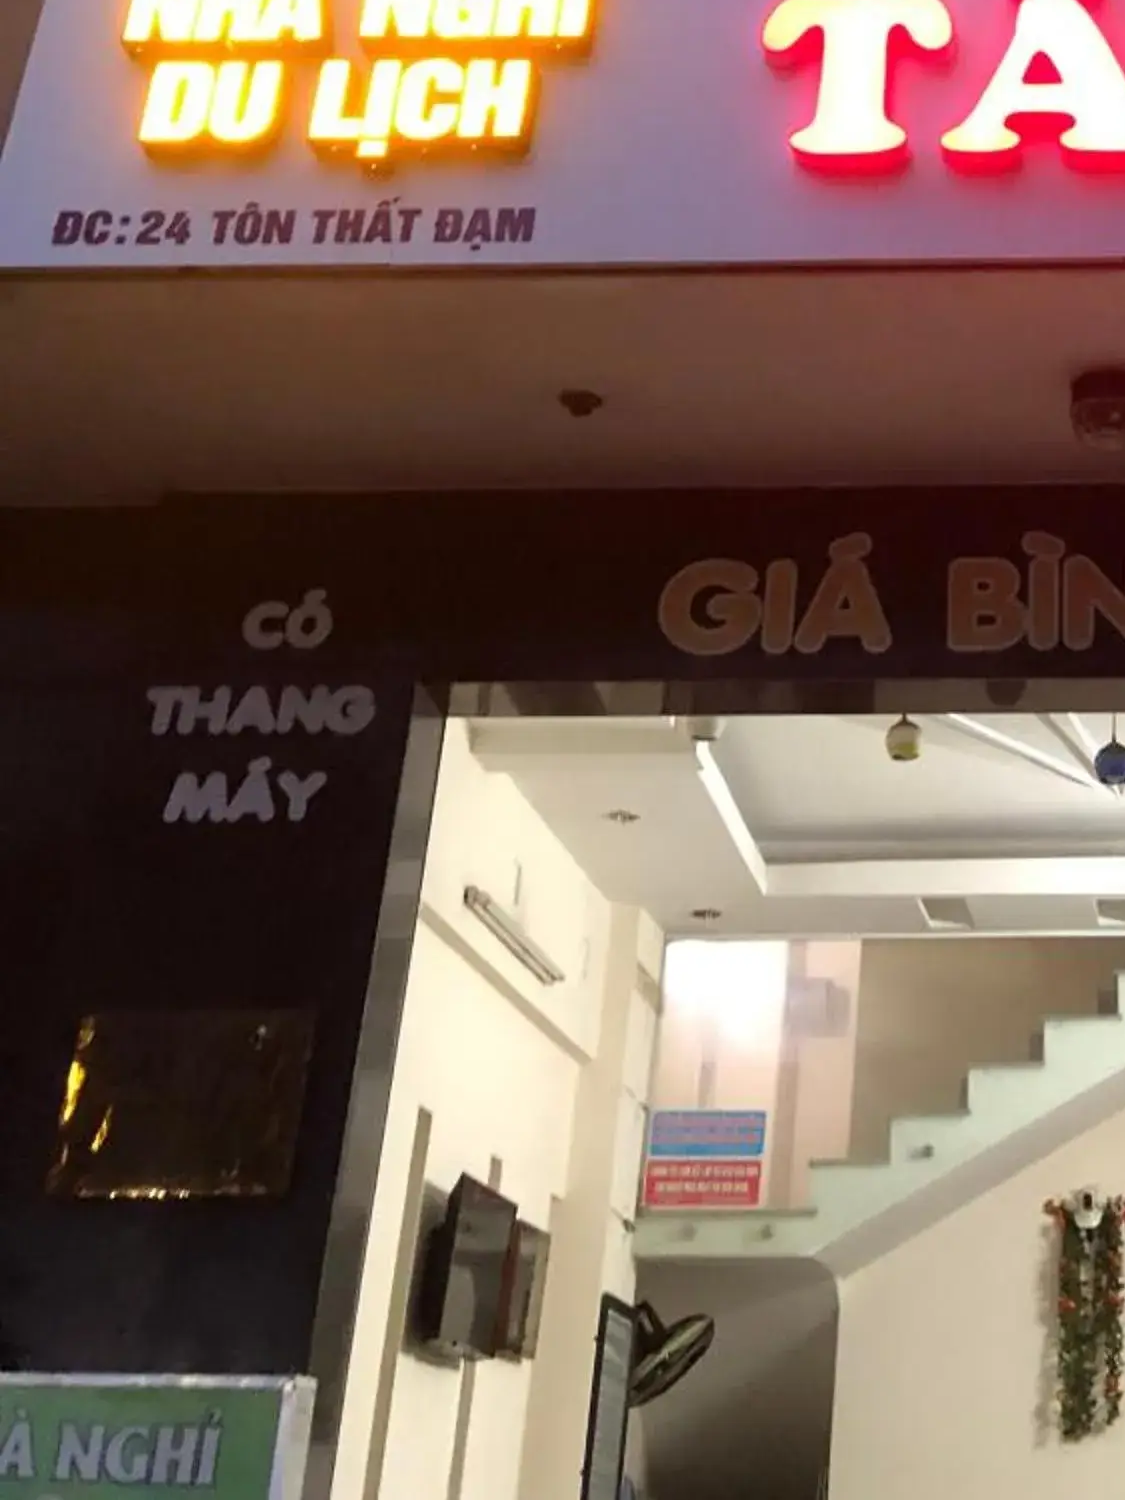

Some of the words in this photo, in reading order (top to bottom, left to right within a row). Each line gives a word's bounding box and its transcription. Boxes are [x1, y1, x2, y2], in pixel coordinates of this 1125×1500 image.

[137, 58, 284, 155] DU
[306, 56, 534, 168] LỊCH
[212, 202, 298, 245] TÔN
[311, 196, 422, 245] THẤT
[432, 206, 537, 251] ĐẠM
[241, 588, 334, 650] CÓ
[656, 531, 893, 656] GIÁ
[146, 684, 377, 736] THANG
[162, 755, 329, 823] MÁY
[54, 1406, 223, 1485] NGHỈ
